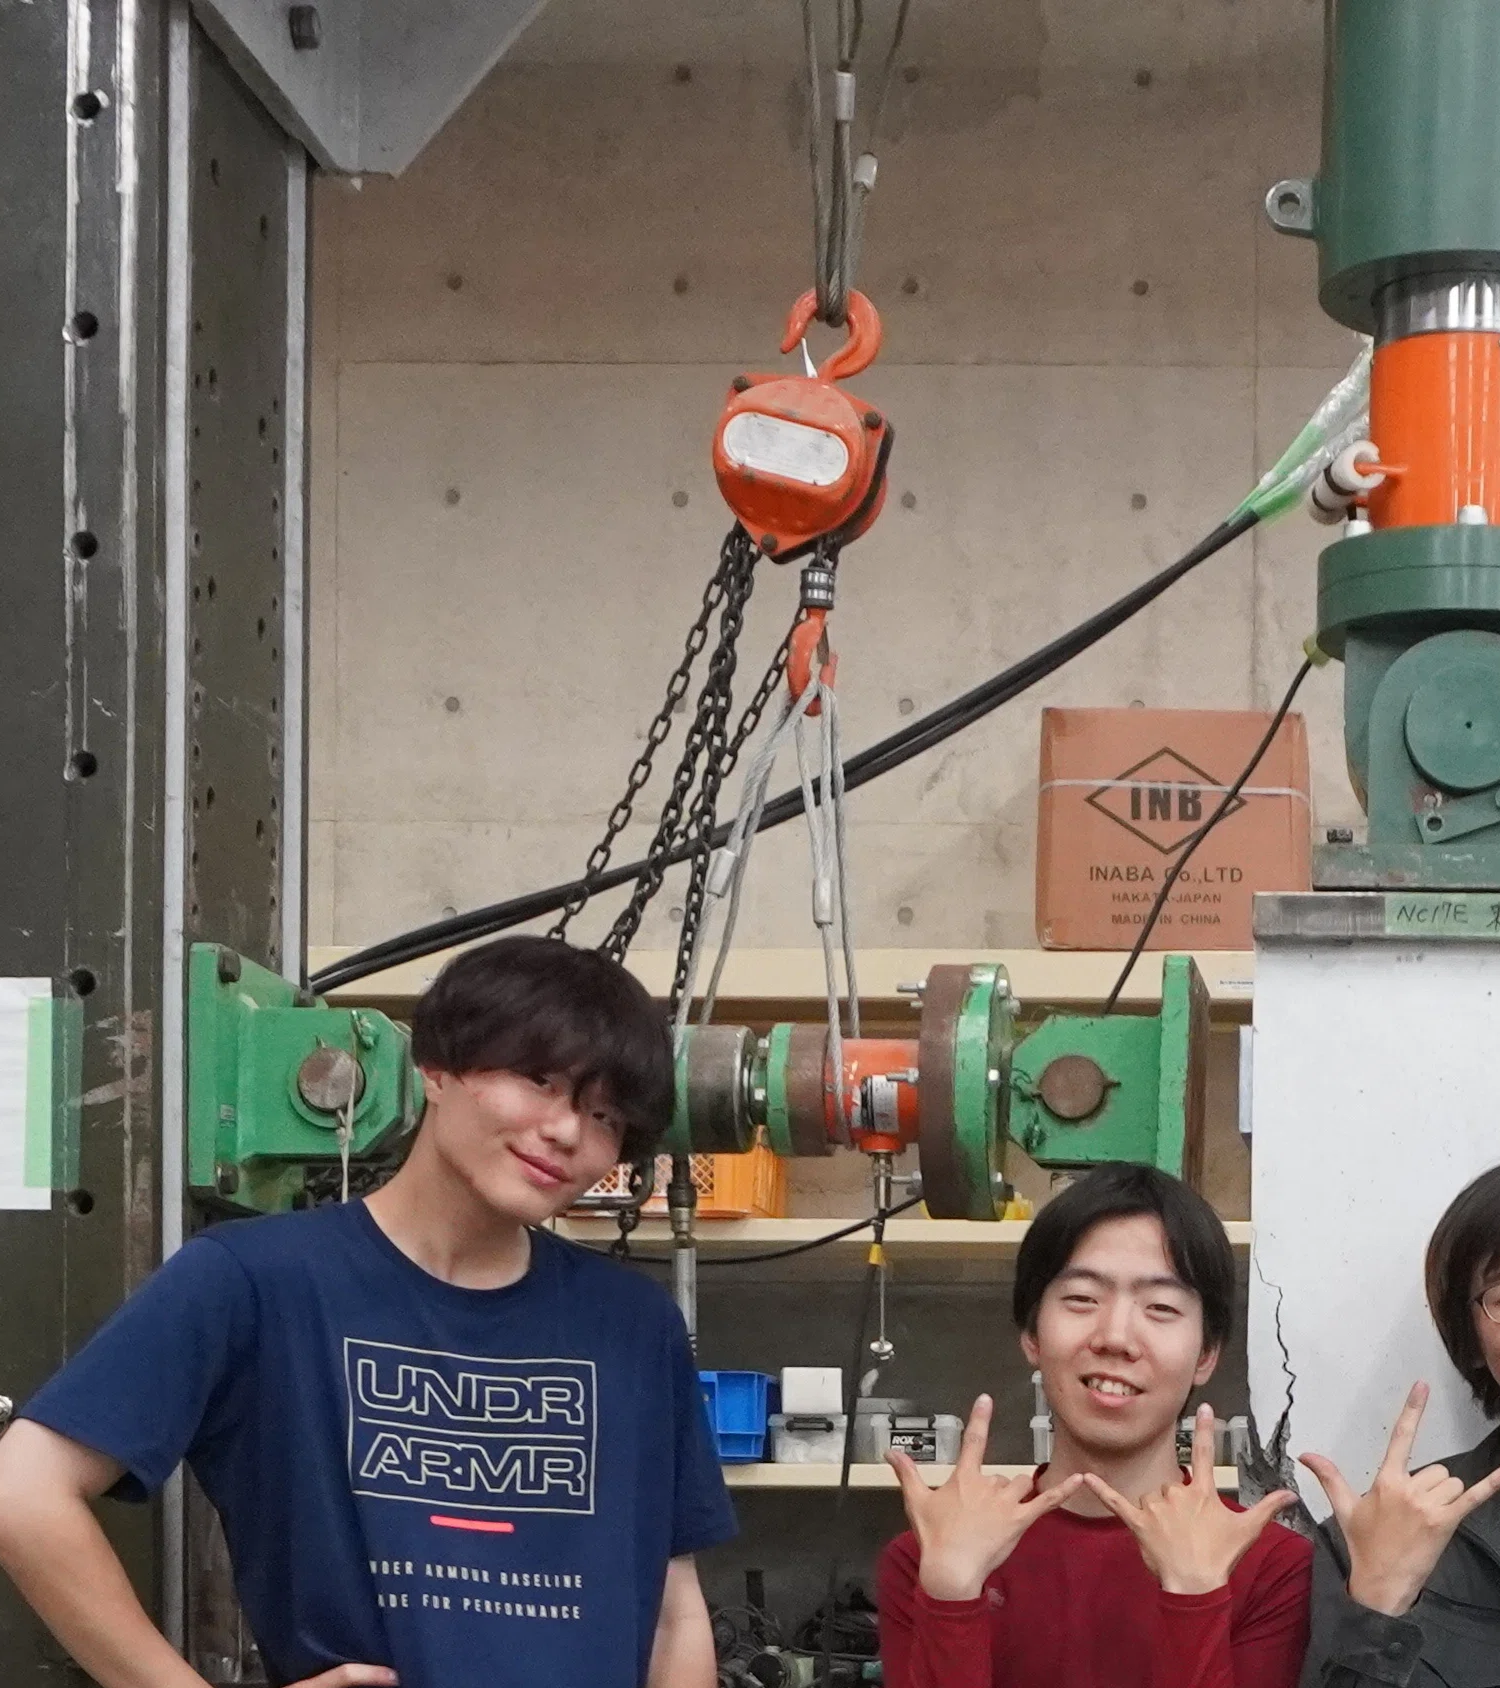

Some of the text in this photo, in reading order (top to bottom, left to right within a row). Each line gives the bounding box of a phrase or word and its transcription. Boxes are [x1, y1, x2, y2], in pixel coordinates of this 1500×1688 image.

[1131, 781, 1202, 821] INB
[1089, 866, 1155, 882] INABA
[1180, 914, 1221, 925] CHINA
[357, 1358, 585, 1425] UNDR
[360, 1432, 586, 1496] ARMR
[369, 1560, 583, 1589] NDER ARMOUR BASELINE
[378, 1593, 582, 1620] ADE FOR PERFORMANCE
